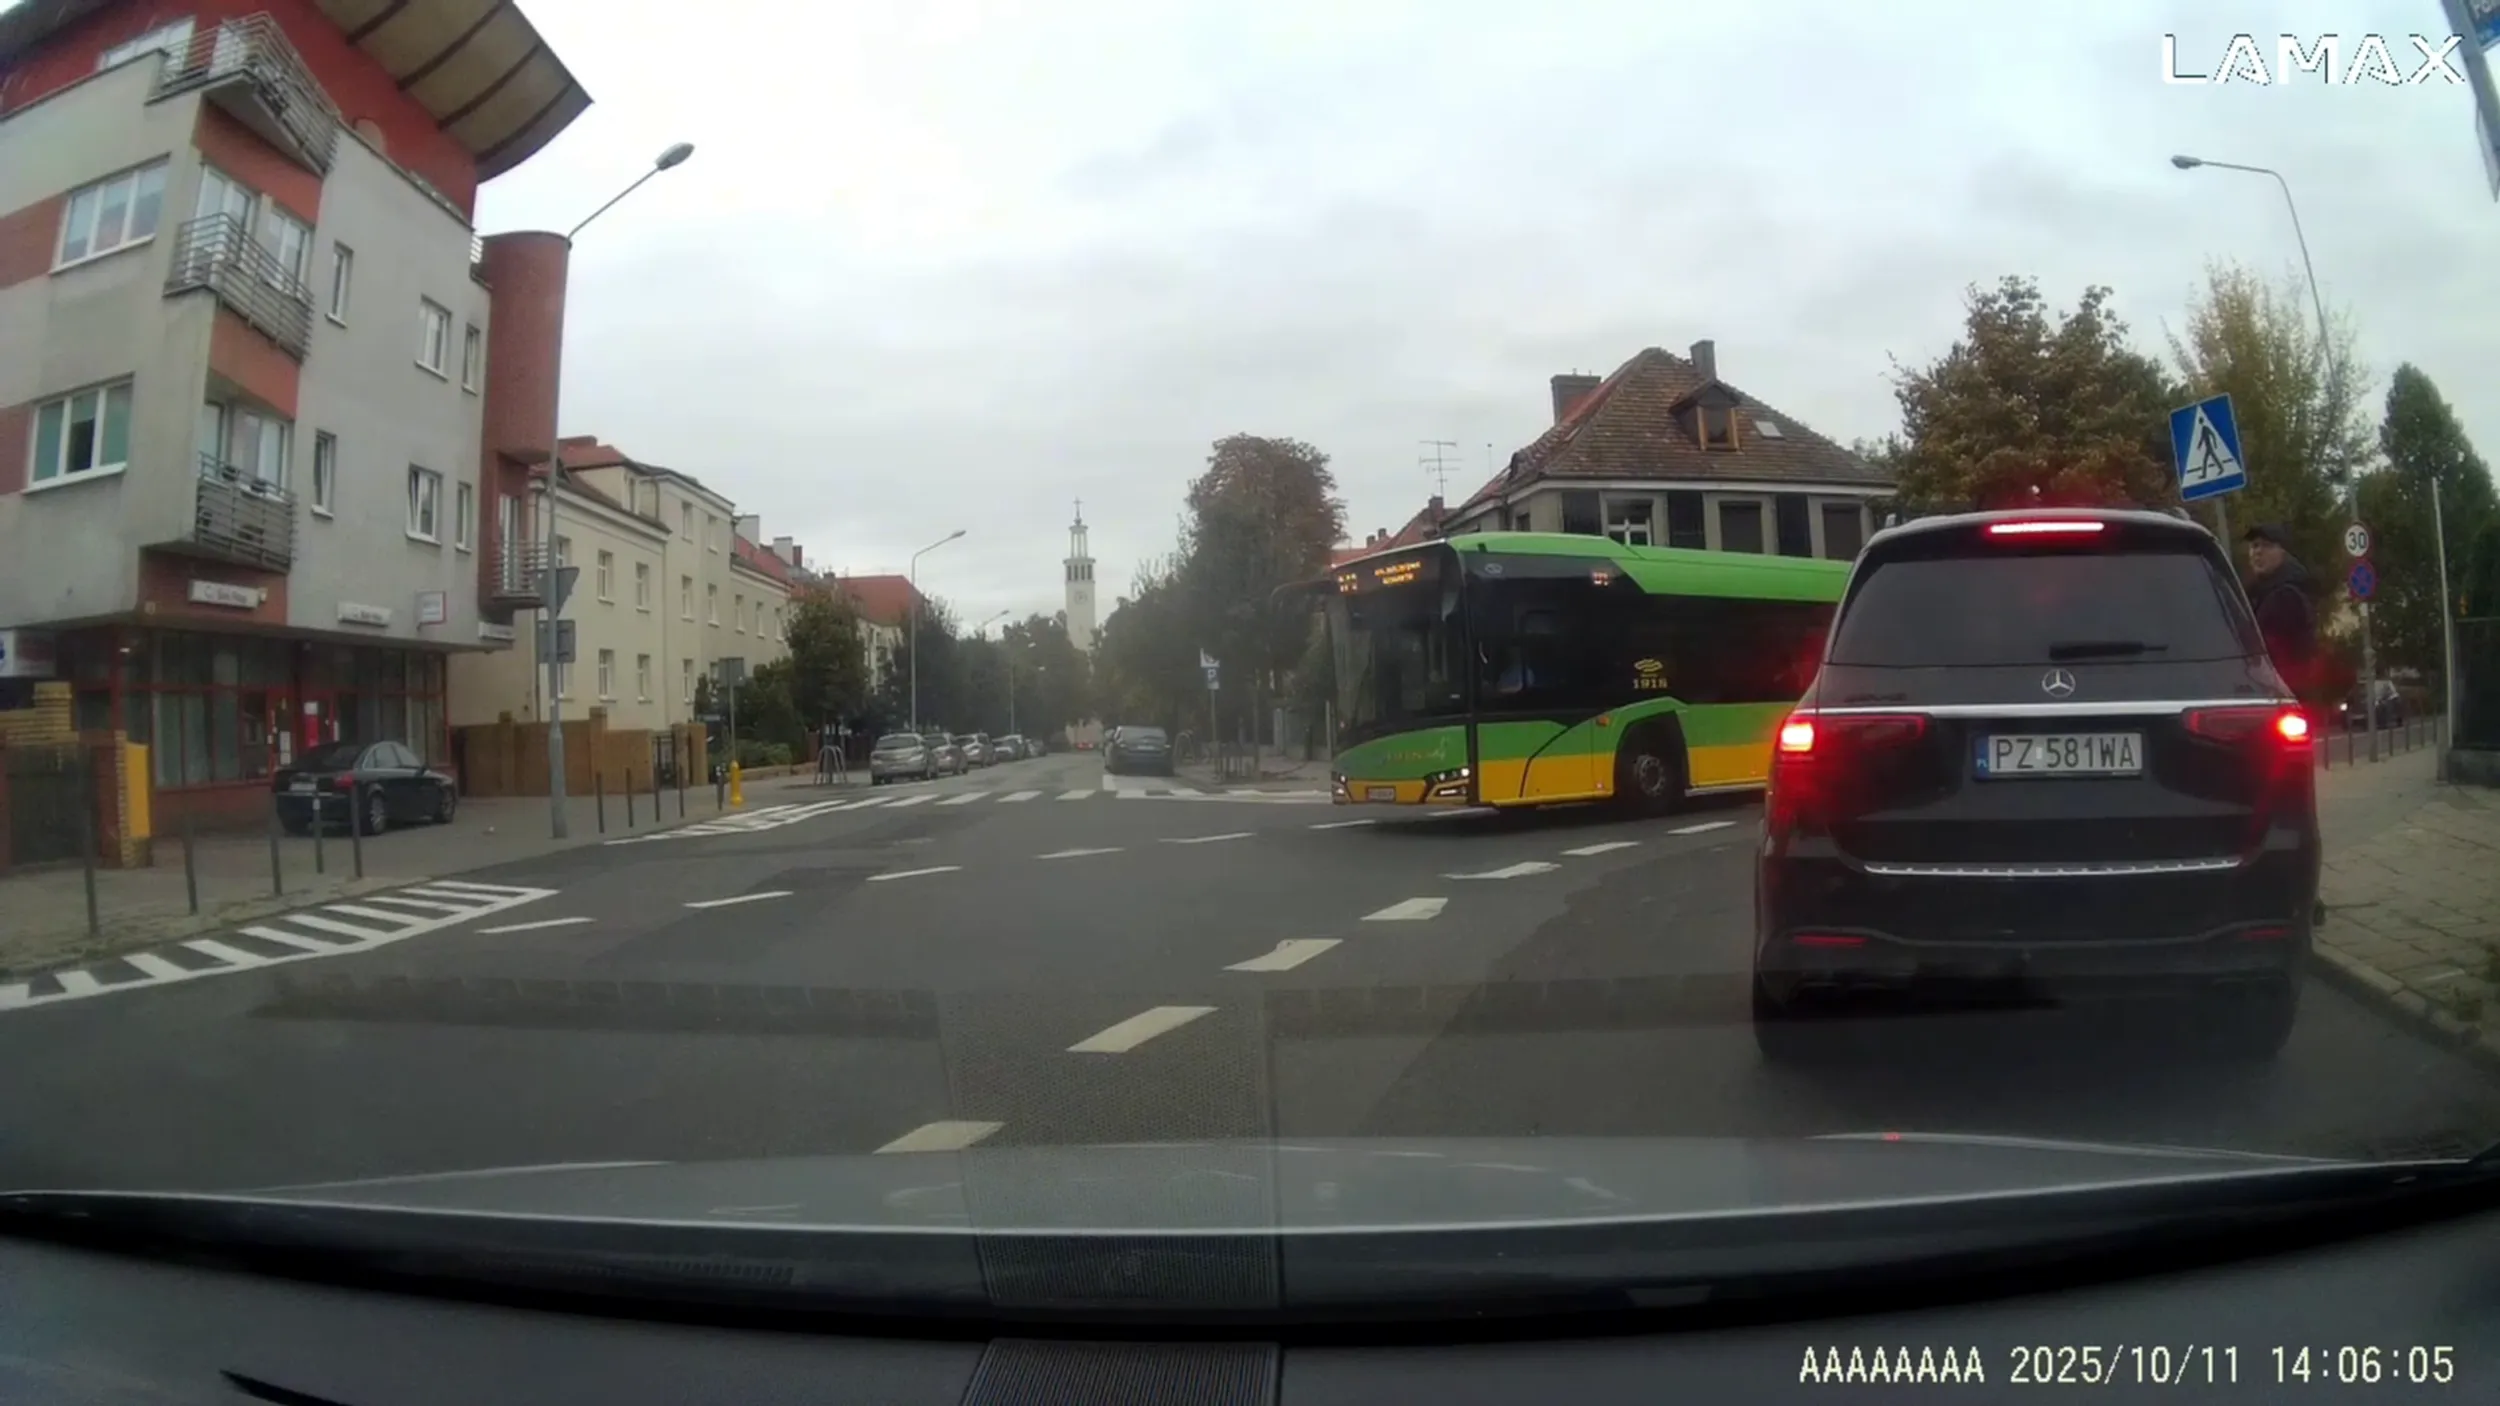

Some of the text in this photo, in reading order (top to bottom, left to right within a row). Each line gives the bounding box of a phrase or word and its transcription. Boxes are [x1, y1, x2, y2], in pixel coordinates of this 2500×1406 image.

[2348, 532, 2366, 550] 30
[1996, 736, 2135, 770] PZ 581WA
